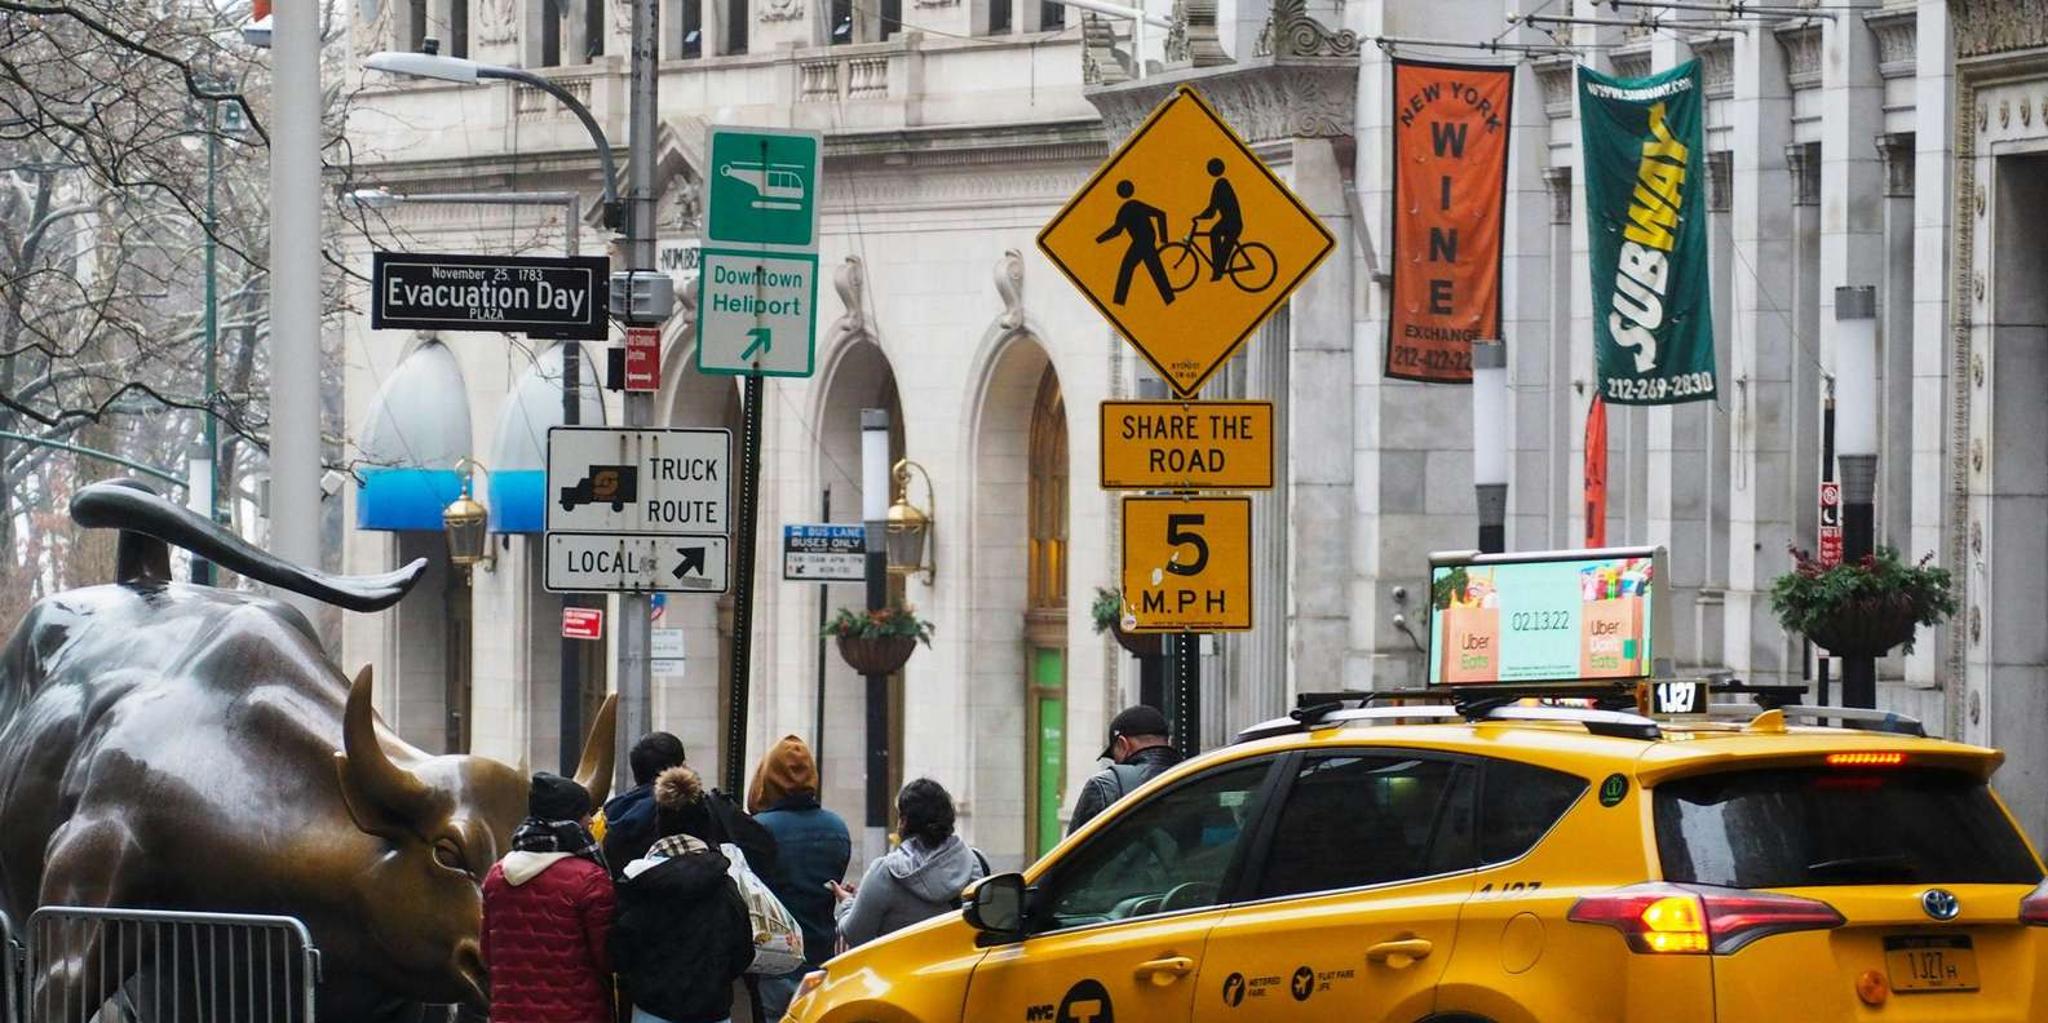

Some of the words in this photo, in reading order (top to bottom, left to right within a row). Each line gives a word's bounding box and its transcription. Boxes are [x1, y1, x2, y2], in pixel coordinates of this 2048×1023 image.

[1401, 81, 1441, 128] NEW
[1450, 81, 1503, 135] YORK
[1429, 121, 1467, 315] WINE
[1608, 101, 1688, 373] SUBWAY
[432, 266, 485, 280] November
[518, 269, 543, 281] 1783
[714, 265, 803, 289] Downtown
[388, 277, 529, 309] Evacuation
[537, 282, 585, 318] Day
[713, 293, 800, 317] Heliport
[469, 307, 505, 320] PLAZA
[1405, 325, 1482, 342] EXCHANGE
[1607, 371, 1714, 400] 212-269-2830
[1122, 416, 1198, 440] SHARE
[1210, 416, 1253, 440] THE
[649, 458, 718, 481] TRUCK
[1150, 449, 1225, 472] ROAD
[648, 501, 718, 524] ROUTE
[791, 538, 828, 548] BUSES
[832, 538, 861, 548] ONLY
[808, 527, 829, 537] BUS
[833, 527, 861, 537] LANE
[1166, 514, 1209, 576] 5
[568, 551, 639, 574] LOCAL
[1512, 610, 1570, 631] 02.13.22
[1591, 620, 1620, 636] Uber
[1462, 633, 1490, 650] Uber
[1657, 682, 1696, 713] 1J27
[1026, 1004, 1055, 1022] NYC
